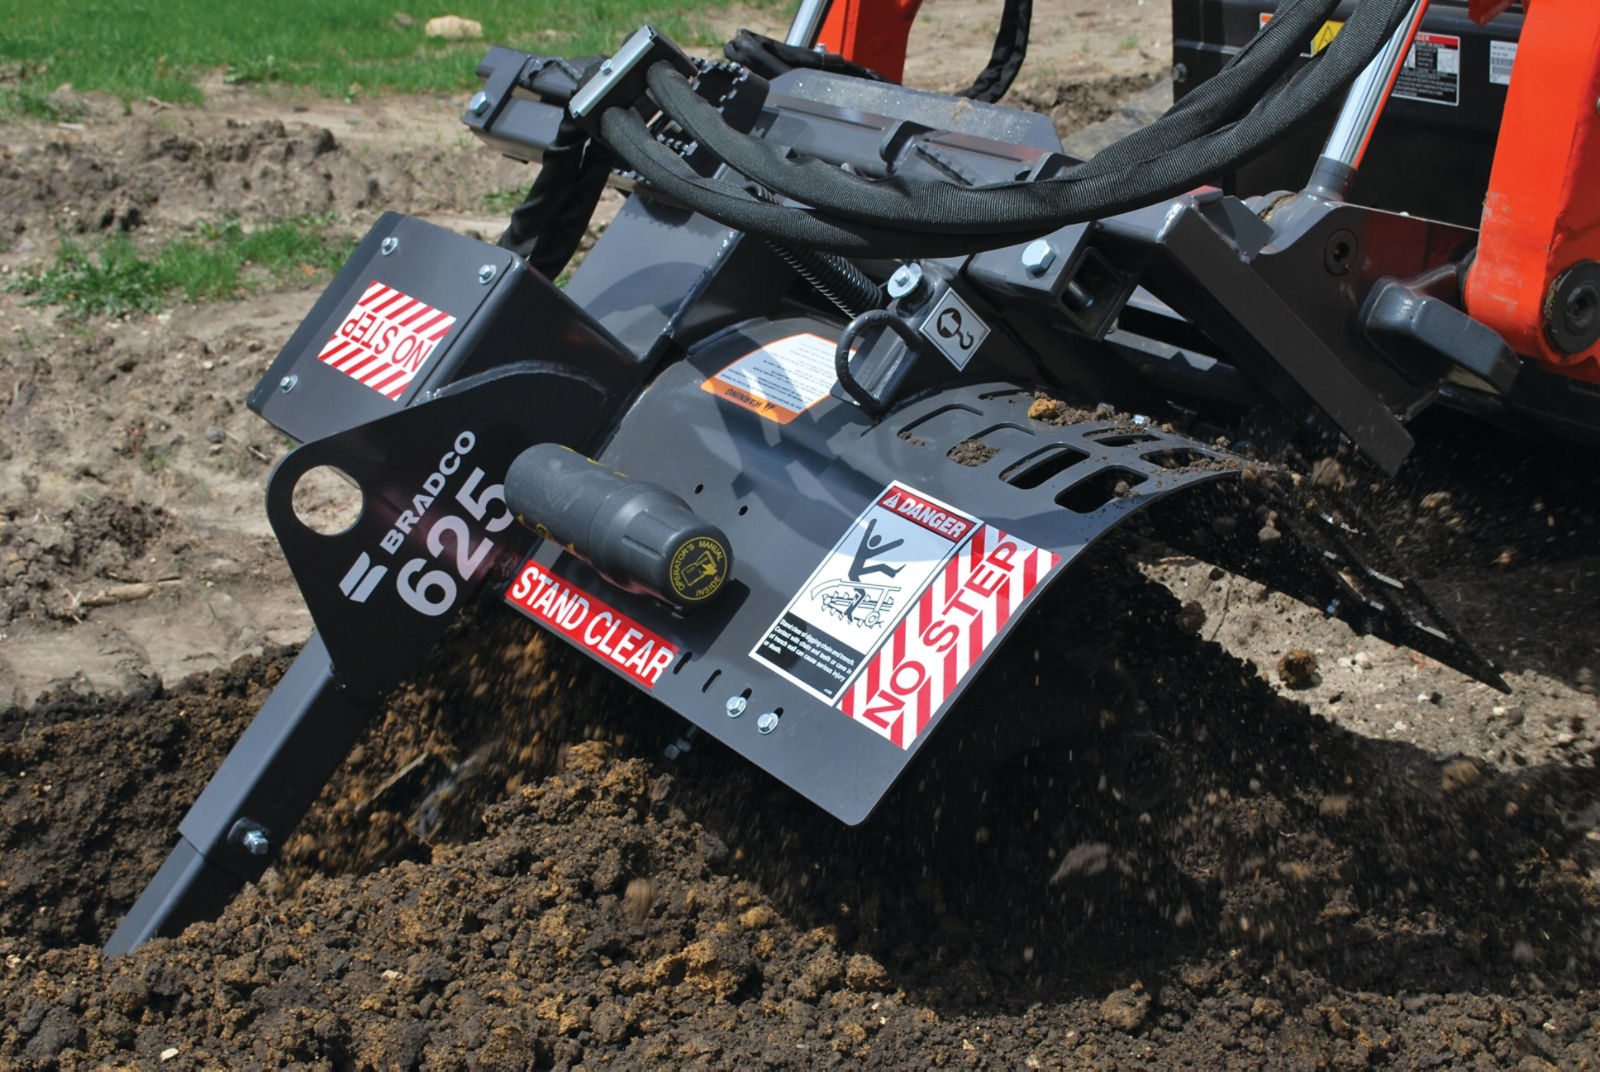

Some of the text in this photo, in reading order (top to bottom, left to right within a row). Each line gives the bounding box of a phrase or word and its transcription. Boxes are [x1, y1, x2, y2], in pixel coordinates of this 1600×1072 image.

[340, 311, 433, 373] NO STEP
[724, 388, 762, 409] WARNING
[379, 430, 476, 555] BRADCO
[898, 497, 967, 539] DANGER
[396, 466, 515, 617] 625
[673, 540, 723, 592] OPERATOR'S MANUAL
[696, 575, 722, 597] INSIDE
[512, 566, 675, 684] STAND CLEAR
[774, 625, 792, 638] Contact
[780, 618, 794, 629] Stand
[861, 540, 1018, 730] NO STEP
